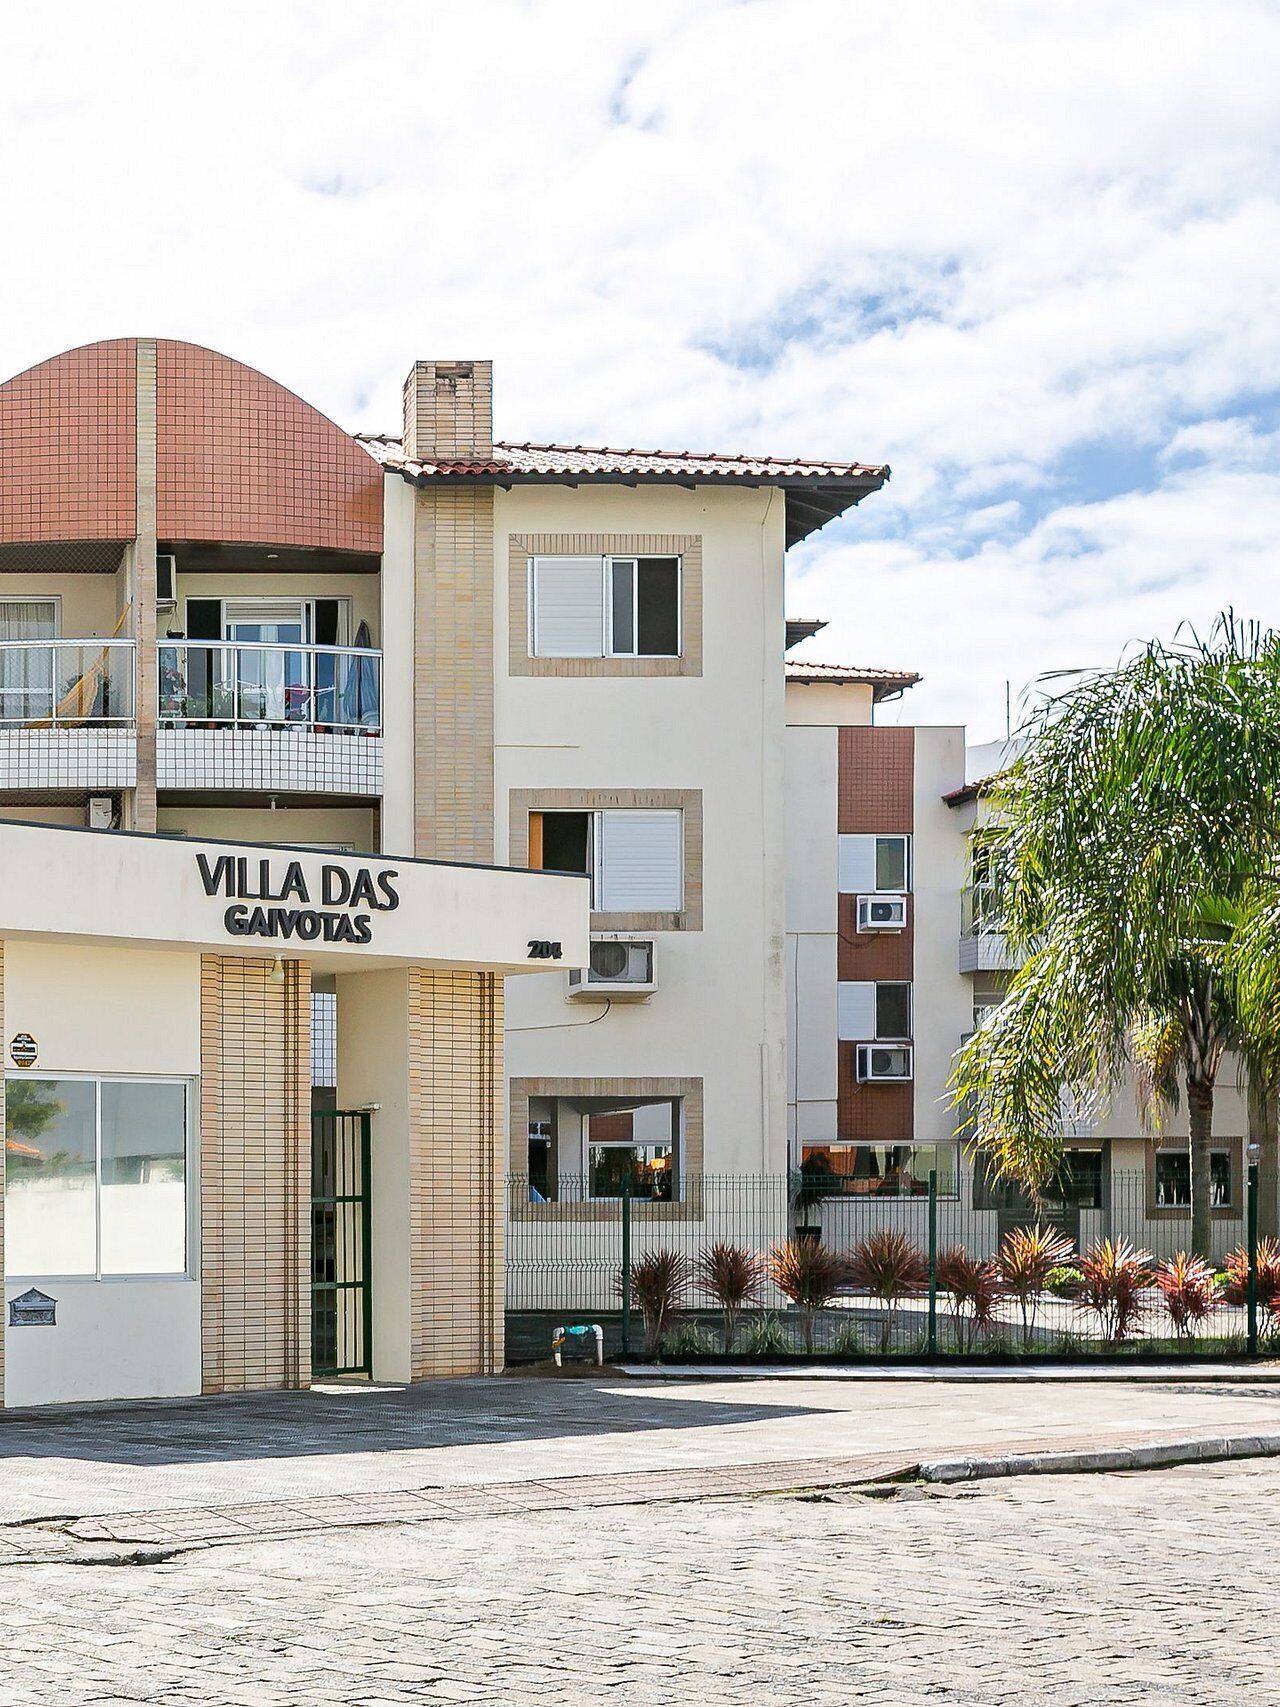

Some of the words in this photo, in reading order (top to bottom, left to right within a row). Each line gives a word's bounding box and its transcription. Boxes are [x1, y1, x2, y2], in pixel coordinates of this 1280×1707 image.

[195, 853, 310, 903] VILLA
[321, 864, 400, 911] DAS
[224, 904, 373, 944] GAIVOTAS
